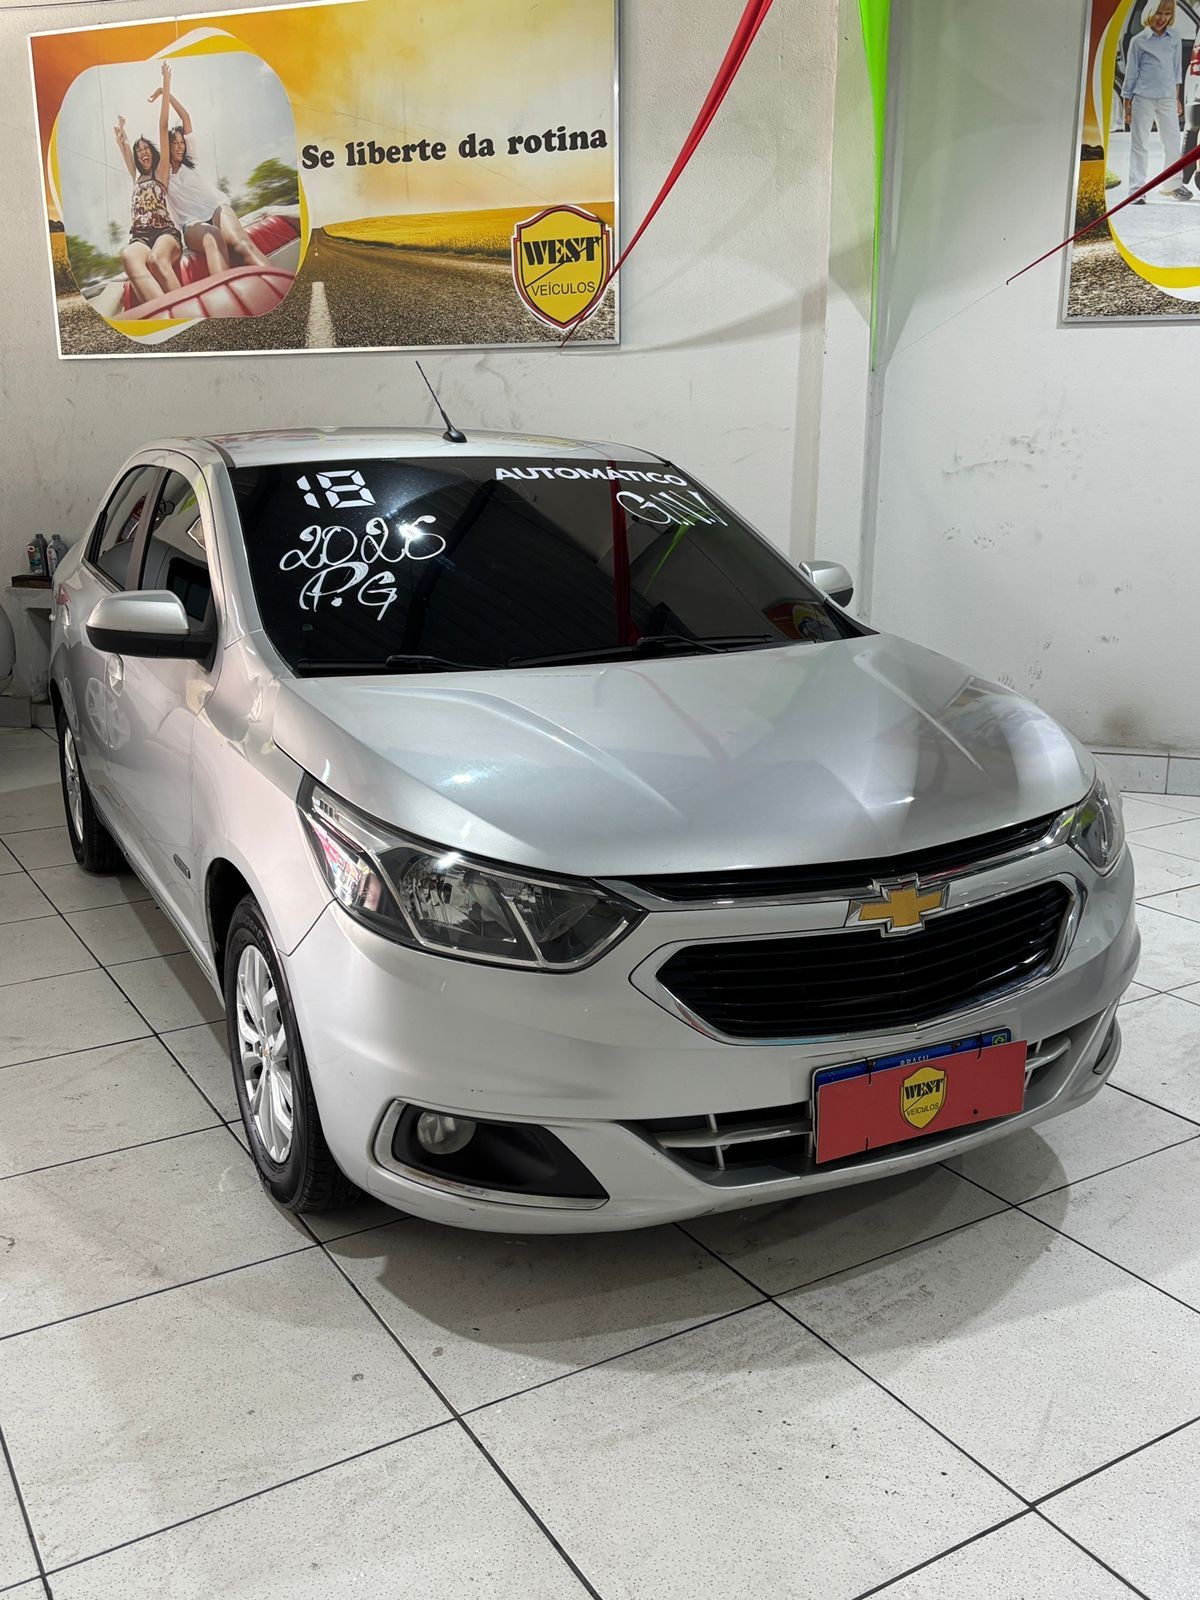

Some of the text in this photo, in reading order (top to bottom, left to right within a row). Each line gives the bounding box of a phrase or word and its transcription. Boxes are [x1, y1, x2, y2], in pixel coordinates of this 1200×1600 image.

[301, 126, 608, 170] Se liberte da rotina
[523, 236, 603, 266] WEST
[531, 281, 597, 297] VEÍCULOS
[296, 470, 376, 509] 18
[495, 466, 688, 487] AUTOMÁTICO
[279, 515, 447, 571] 2026
[904, 1078, 945, 1100] WEST
